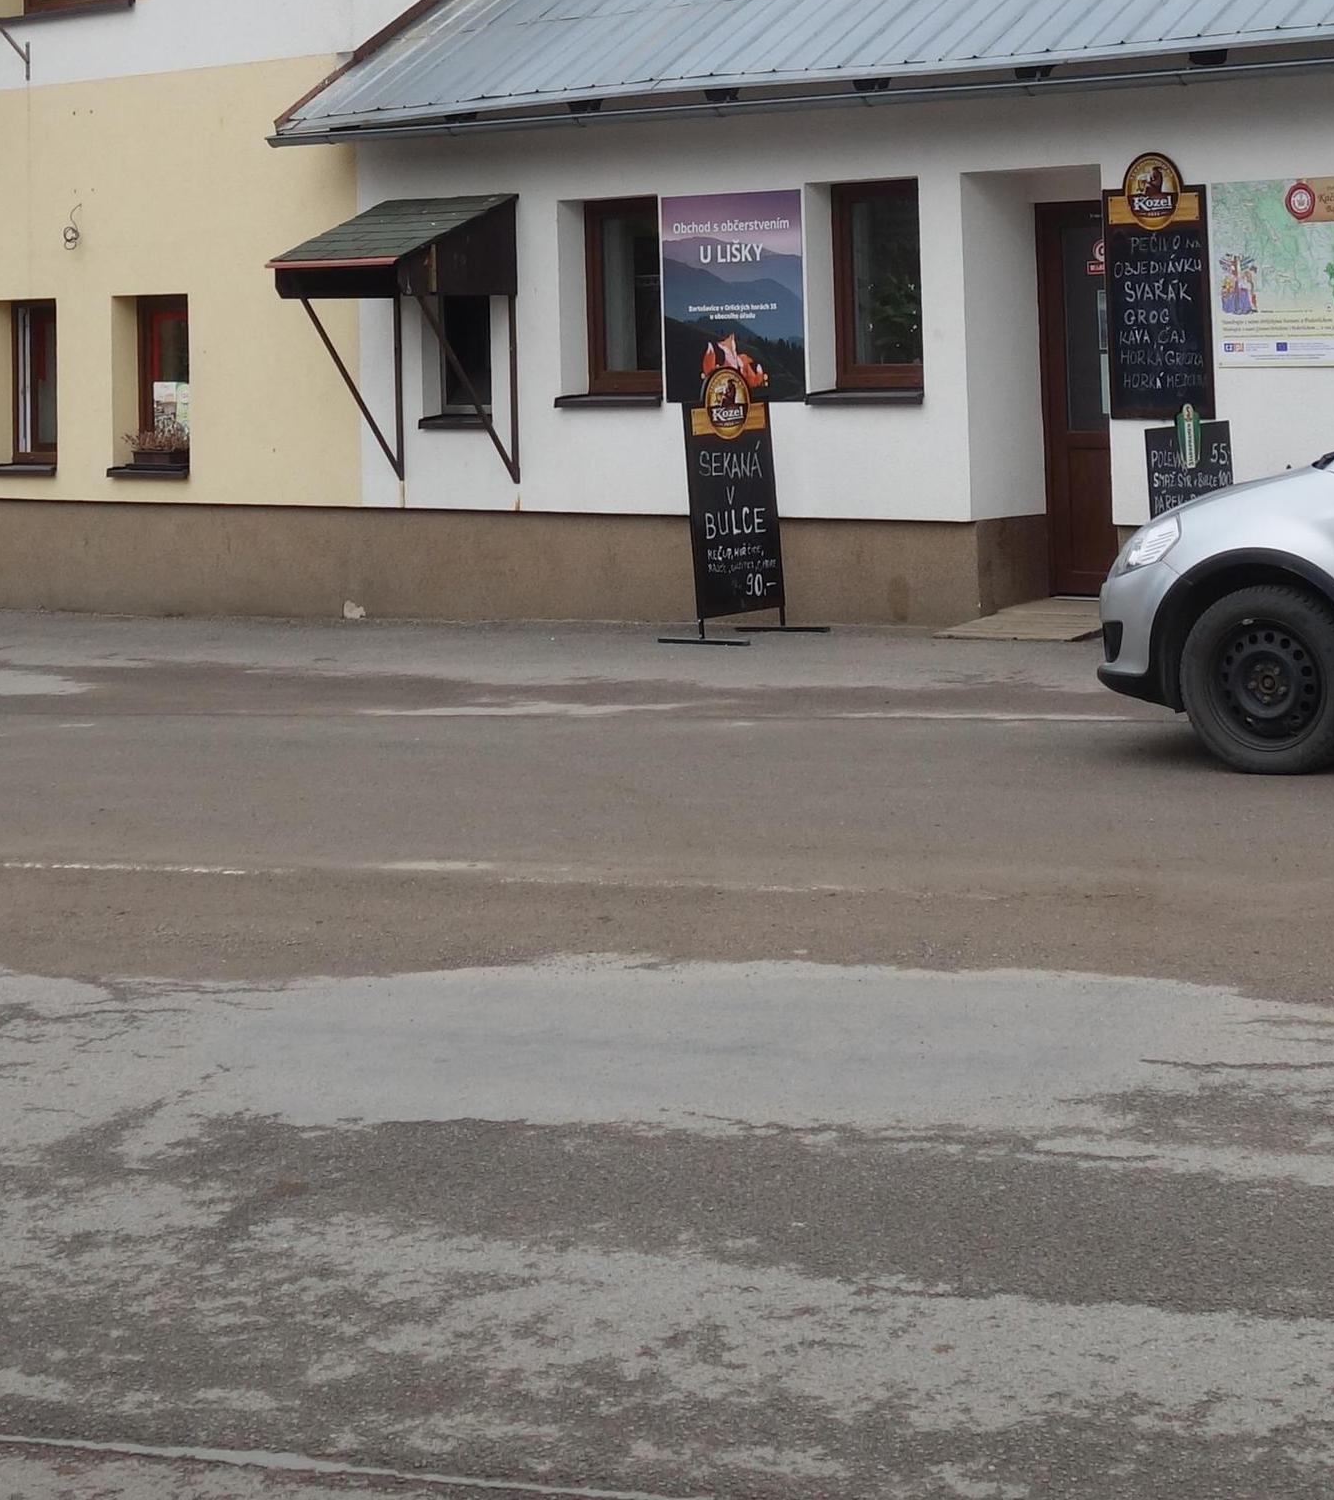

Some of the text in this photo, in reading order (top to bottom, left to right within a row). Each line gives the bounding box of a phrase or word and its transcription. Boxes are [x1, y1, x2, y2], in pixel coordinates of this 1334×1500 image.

[1133, 195, 1173, 211] Kozel
[673, 217, 790, 234] Obchod s občerstvením
[700, 240, 764, 264] U LIŠKY
[1114, 254, 1202, 278] OBJEDNÁVKU
[1125, 278, 1192, 302] SVAŘÁK
[1124, 308, 1170, 325] GROG
[1157, 326, 1186, 344] ČAJ
[1121, 345, 1164, 365] HORKÁ
[1123, 372, 1164, 389] HORKÁ
[711, 406, 744, 422] Kozel
[699, 440, 763, 479] SEKANÁ
[727, 486, 735, 505] V
[705, 506, 767, 540] BULCE
